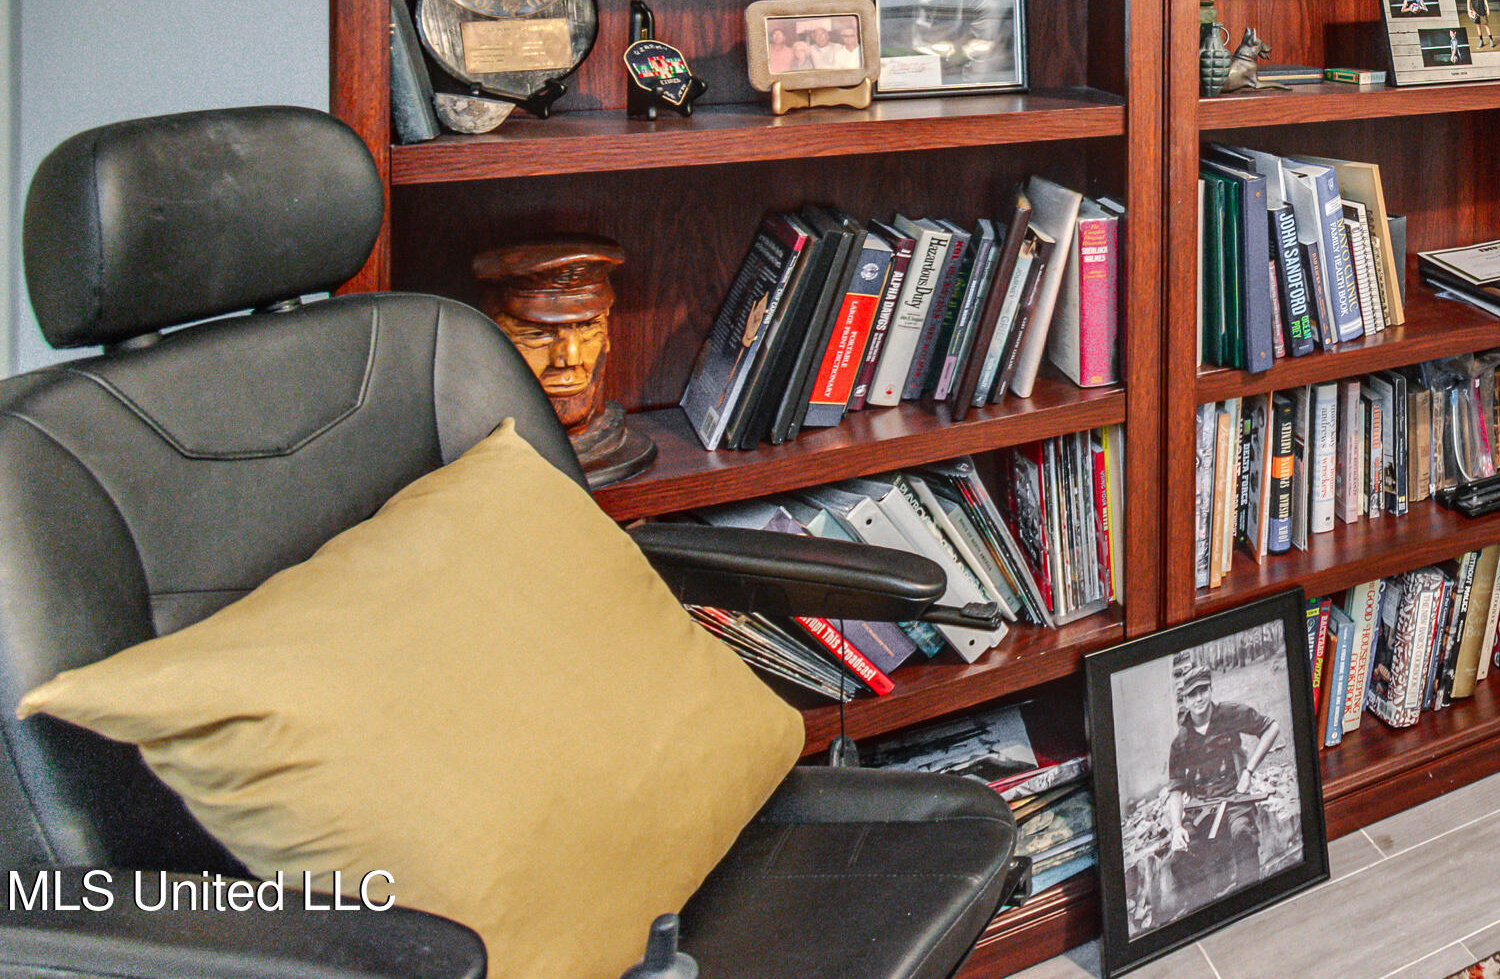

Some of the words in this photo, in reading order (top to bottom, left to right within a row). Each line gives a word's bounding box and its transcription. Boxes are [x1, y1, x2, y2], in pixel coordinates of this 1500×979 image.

[1280, 212, 1299, 248] JOHN
[1330, 222, 1340, 254] FAMILY
[917, 237, 947, 286] Hazardous
[1334, 255, 1346, 288] HEALTH
[1337, 218, 1349, 262] MAYO
[1344, 264, 1358, 313] CLINIC
[885, 271, 904, 300] ALPHA
[906, 287, 933, 309] Duty
[1284, 248, 1307, 316] SANDFORD
[845, 301, 858, 325] LARGE
[876, 302, 895, 330] DAWGS
[1339, 288, 1349, 318] BOOK
[839, 327, 850, 349] PRINT
[1291, 320, 1301, 339] PREY
[1301, 315, 1312, 340] OCEAN
[841, 331, 857, 368] PORTABLE
[824, 351, 844, 397] DICTIONARY
[1281, 421, 1292, 454] PARTNERS
[1319, 407, 1330, 448] andrews
[1242, 443, 1250, 476] DELTA
[1280, 458, 1290, 489] SPARRING
[1241, 475, 1249, 506] FORCE
[1320, 457, 1330, 498] wreckers
[1279, 493, 1290, 523] GRISHAM
[1278, 525, 1288, 543] JOHN
[1364, 589, 1376, 621] GOOD
[1461, 585, 1471, 613] MALICE
[1317, 615, 1328, 657] BACKYARD
[821, 627, 841, 650] This
[836, 641, 877, 682] Broadcast
[1312, 657, 1324, 689] PHYSICS
[1344, 652, 1355, 715] COOKBOOK
[1353, 628, 1371, 715] HOUSEKEEPING
